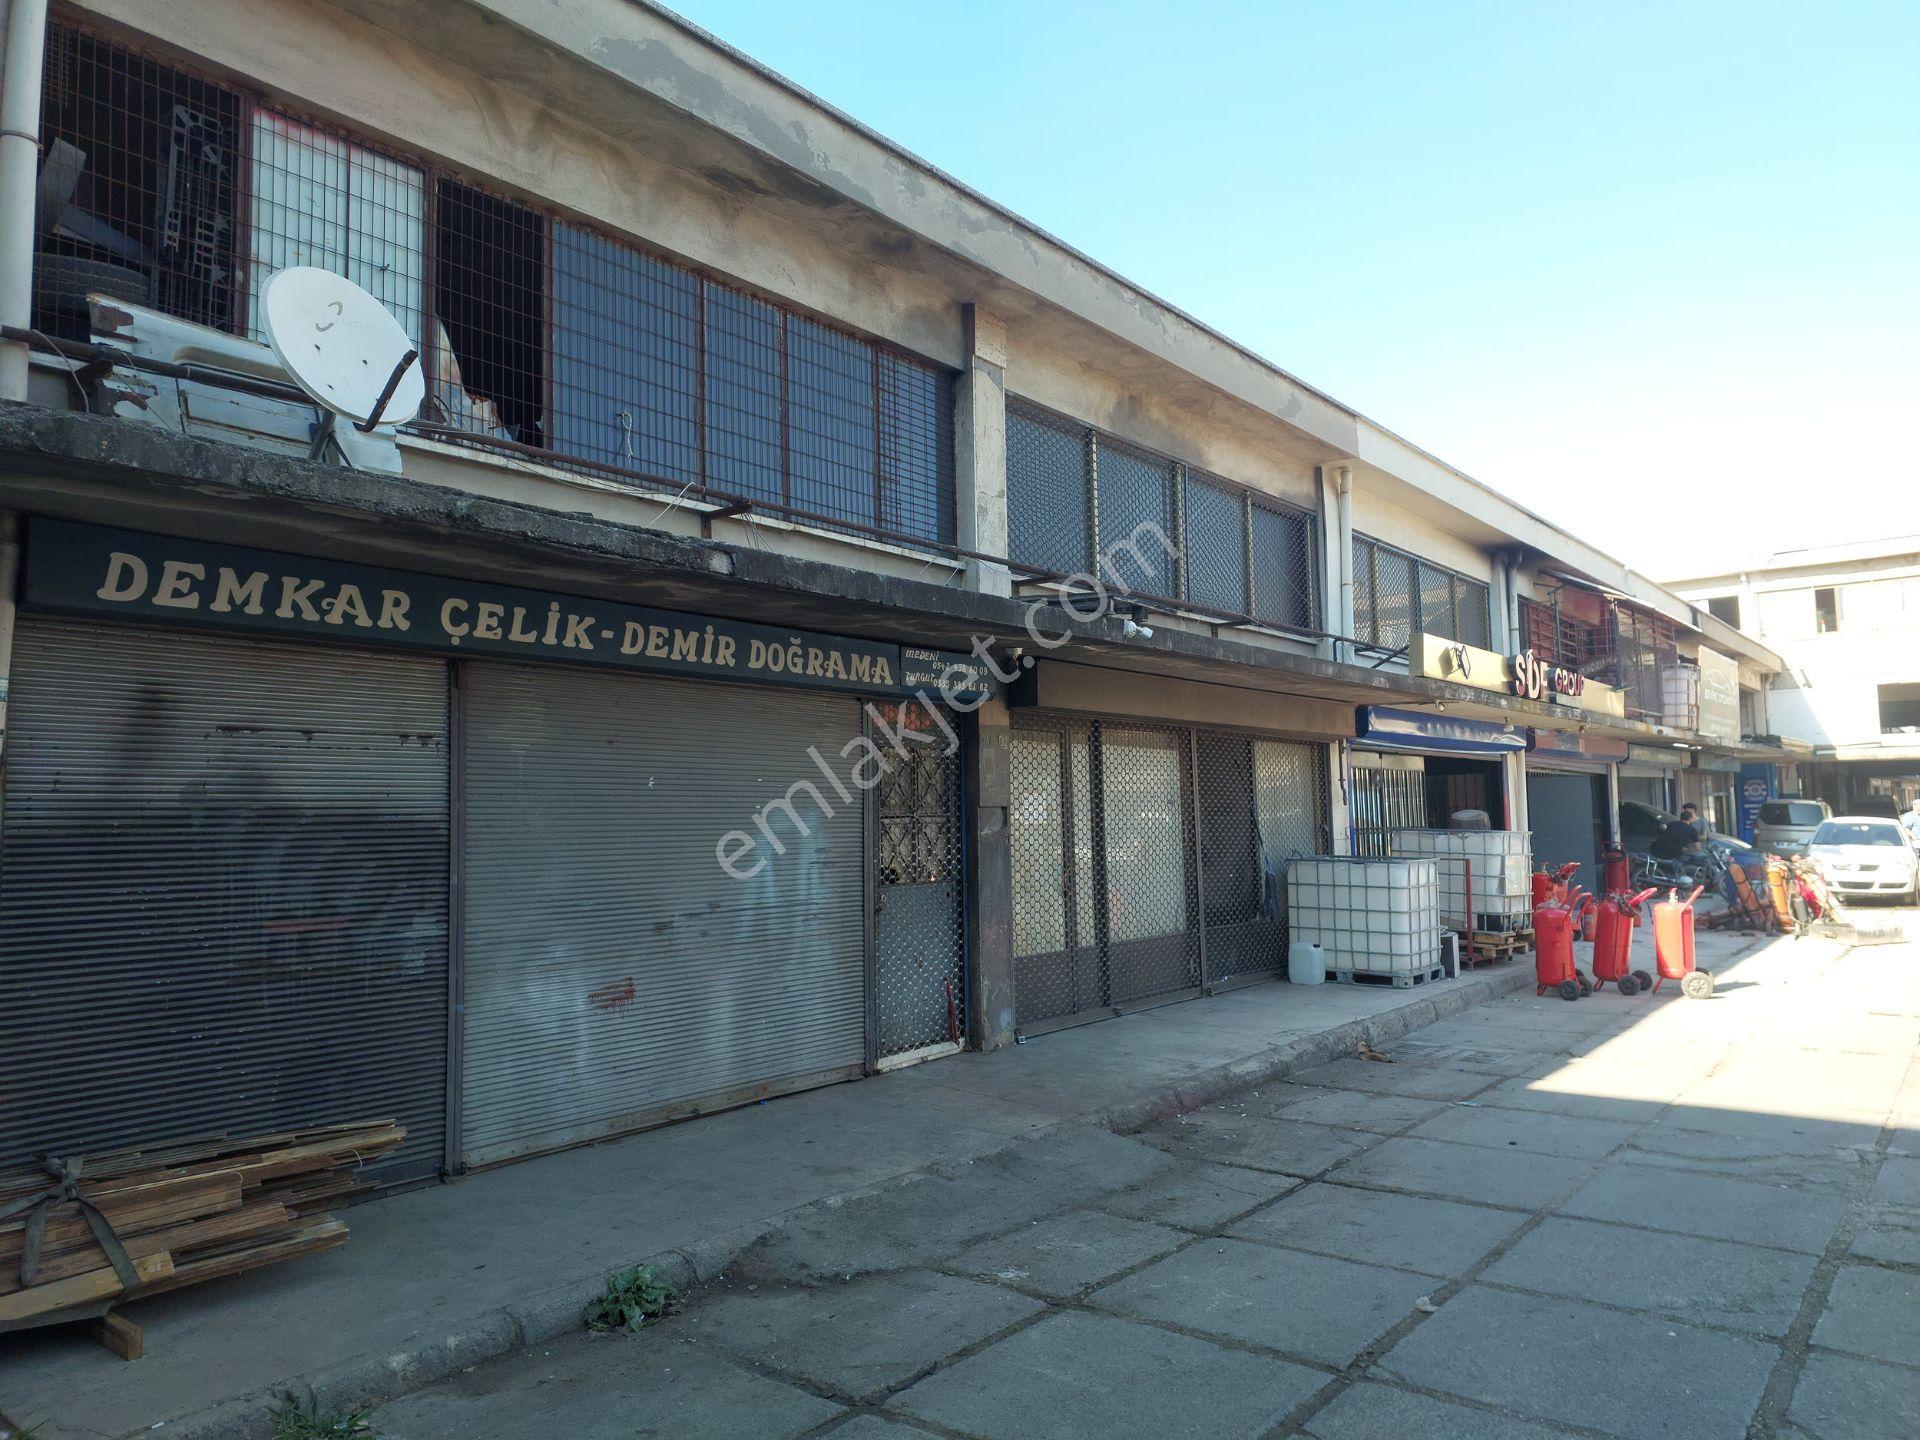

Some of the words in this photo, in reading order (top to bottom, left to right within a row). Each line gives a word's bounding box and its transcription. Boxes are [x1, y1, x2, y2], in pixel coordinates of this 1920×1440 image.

[96, 551, 412, 632] DEMKAR
[748, 636, 894, 686] DOĞRAMA
[1554, 667, 1585, 696] GROUP
